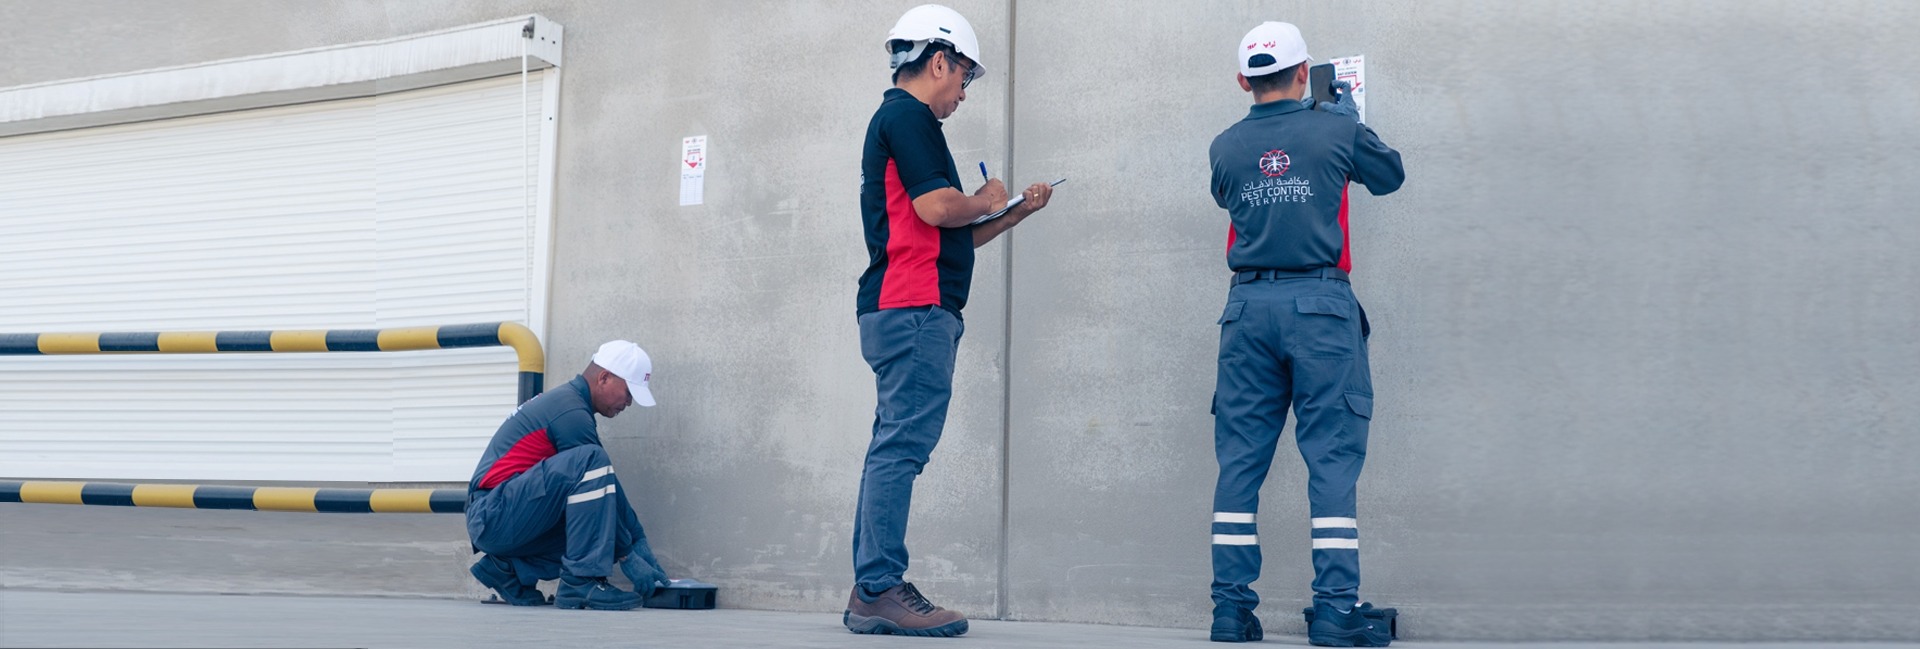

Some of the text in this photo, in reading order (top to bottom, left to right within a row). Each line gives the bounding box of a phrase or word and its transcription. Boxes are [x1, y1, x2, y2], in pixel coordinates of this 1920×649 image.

[1276, 176, 1309, 186] مكافحة
[1241, 185, 1314, 201] PEST CONTROL
[1249, 195, 1306, 207] SERVICES
